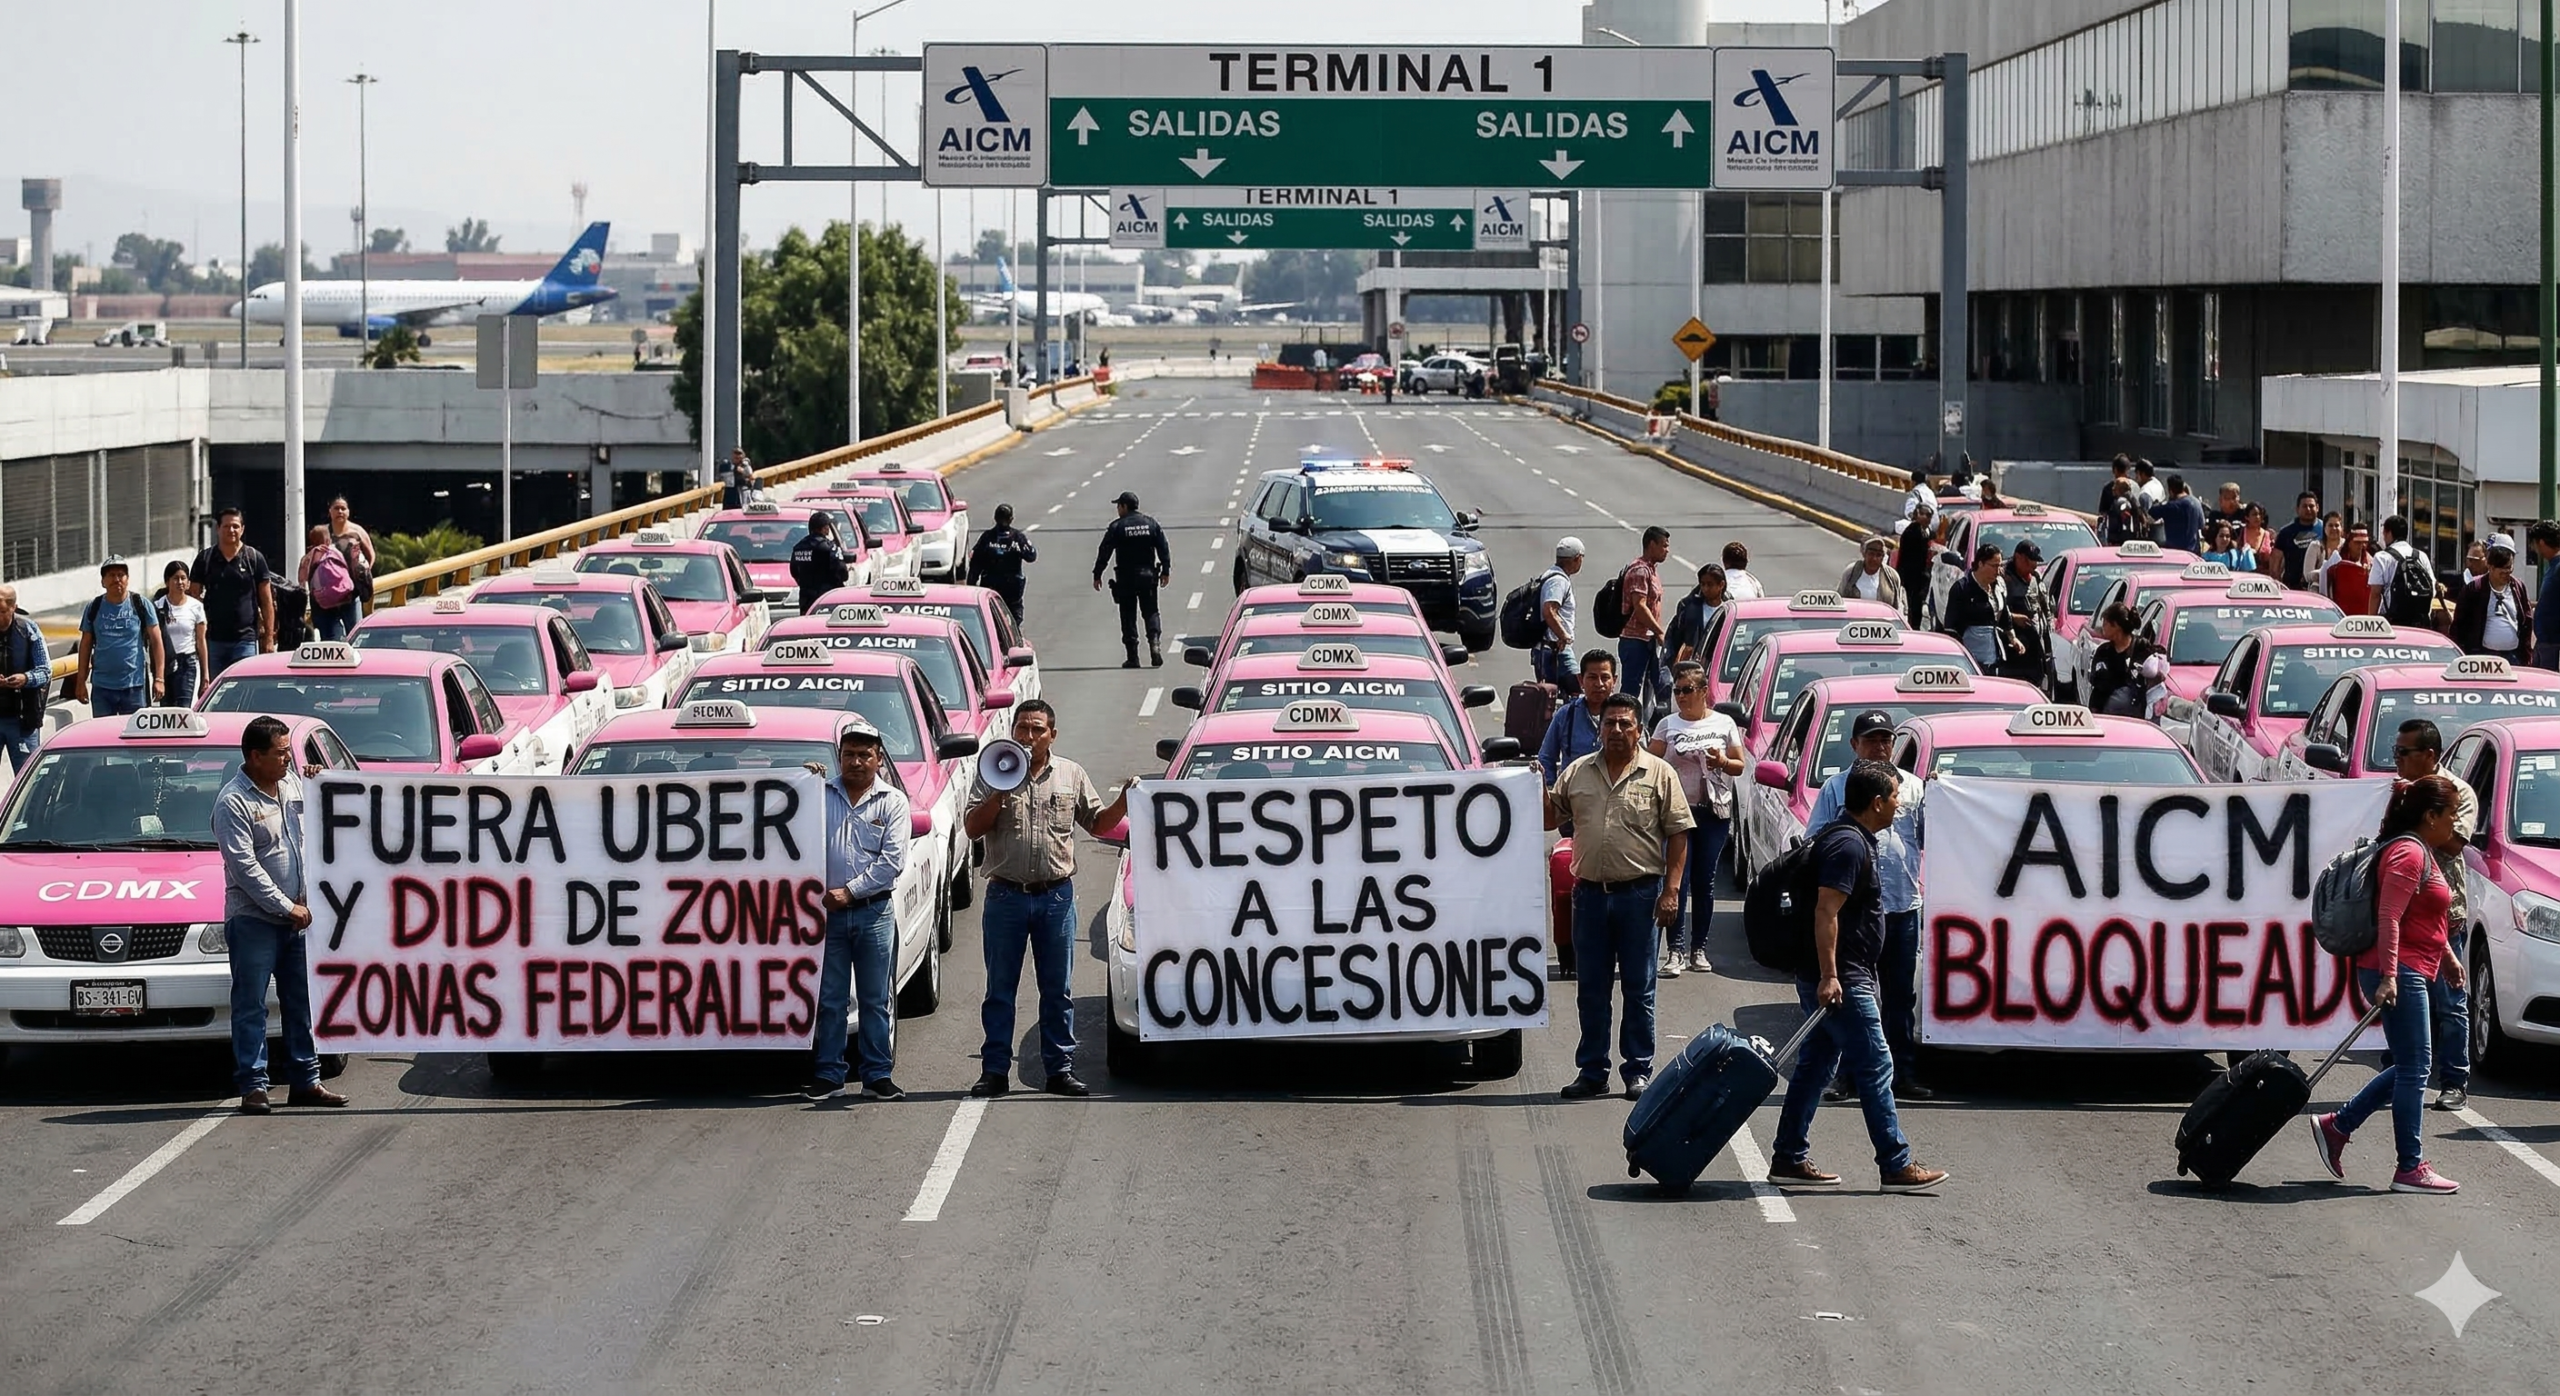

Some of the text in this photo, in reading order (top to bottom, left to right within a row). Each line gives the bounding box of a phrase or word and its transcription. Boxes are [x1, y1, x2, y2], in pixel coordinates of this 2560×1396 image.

[1209, 52, 1553, 94] TERMINAL 1
[1128, 109, 1281, 137] SALIDAS
[1476, 111, 1628, 138] SALIDAS
[938, 127, 1031, 152] AICM
[1726, 130, 1819, 155] AICM
[1245, 188, 1398, 205] TERMINAL 1
[1116, 221, 1158, 233] AICM
[1202, 212, 1274, 227] SALIDAS
[1363, 213, 1435, 228] SALIDAS
[1480, 223, 1523, 236] AICM
[1309, 578, 1344, 590] CDMX
[1800, 594, 1836, 606] CDMX
[838, 608, 877, 621] CDMX
[900, 605, 951, 616] AICM
[1313, 607, 1351, 621] CDMX
[2261, 608, 2313, 620] AICM
[1848, 626, 1892, 639] CDMX
[2345, 620, 2385, 633] CDMX
[857, 637, 917, 648] AICM
[300, 646, 345, 660] CDMX
[774, 646, 820, 659] CDMX
[1312, 649, 1355, 663] CDMX
[2303, 647, 2431, 662] SITIO AICM
[2457, 660, 2504, 674] CDMX
[721, 677, 864, 693] SITIO AICM
[1912, 670, 1960, 685] CDMX
[1261, 681, 1405, 696] SITIO AICM
[2413, 692, 2557, 708] SITIO AICM
[135, 713, 189, 730] CDMX
[1289, 707, 1342, 723] CDMX
[2031, 710, 2085, 727] CDMX
[1231, 745, 1400, 761] SITIO AICM
[320, 778, 801, 864] FUERA UBER
[1151, 783, 1512, 871] RESPETO
[1996, 791, 2311, 901] AICM
[38, 880, 203, 902] CDMX
[1231, 874, 1437, 937] A LAS
[318, 880, 365, 951] Y
[391, 876, 533, 948] DIDI
[565, 879, 641, 947] DE
[662, 878, 826, 947] ZONAS
[1144, 936, 1545, 1028] CONCESIONES
[314, 958, 819, 1038] ZONAS FEDERALES
